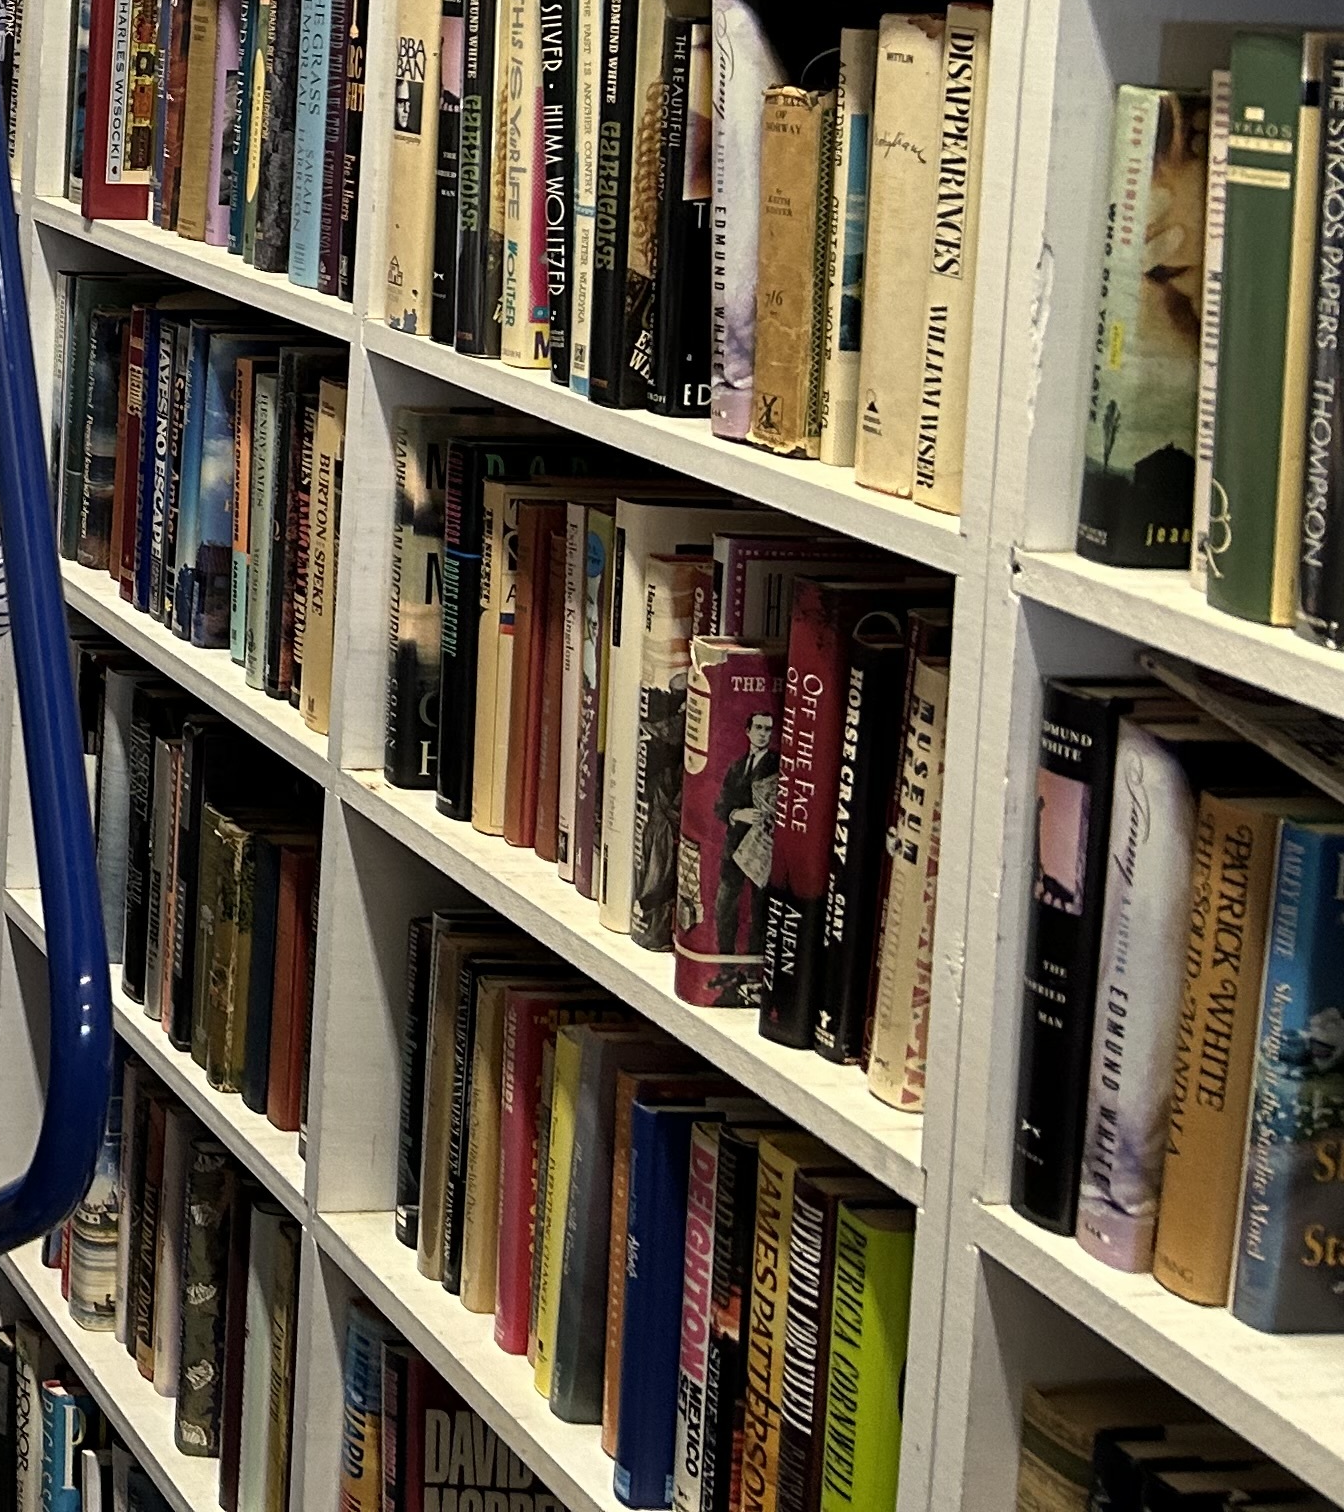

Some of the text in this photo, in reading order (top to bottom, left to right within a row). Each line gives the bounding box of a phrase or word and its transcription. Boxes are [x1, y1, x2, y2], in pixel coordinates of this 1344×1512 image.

[110, 77, 127, 161] WYSOCKI
[309, 32, 327, 116] GRASS
[540, 3, 568, 297] SILVER HILMA WOLITZER
[666, 66, 686, 148] BEAUTIFUL
[713, 206, 728, 291] EDMUND
[914, 30, 979, 490] DISAPPEARANCES WILLIAM WISER
[1301, 245, 1342, 568] PAPERS THOMPSON
[150, 458, 167, 559] ESCAPE
[310, 452, 334, 617] BURTON SPEKE
[790, 672, 825, 832] OFF FACE
[831, 666, 865, 865] HORSE CRAZY
[903, 698, 936, 865] MUSEUM
[779, 904, 804, 976] ALJEAN
[1193, 824, 1256, 1113] PATRICK WHITE
[1099, 983, 1132, 1091] EDMUND
[679, 1145, 718, 1478] DEIGHTON MEXICO
[788, 1194, 825, 1310] PATRICIA
[744, 1166, 787, 1512] JAMES PATTERSON
[822, 1217, 869, 1504] PATRICIA CORNWELL
